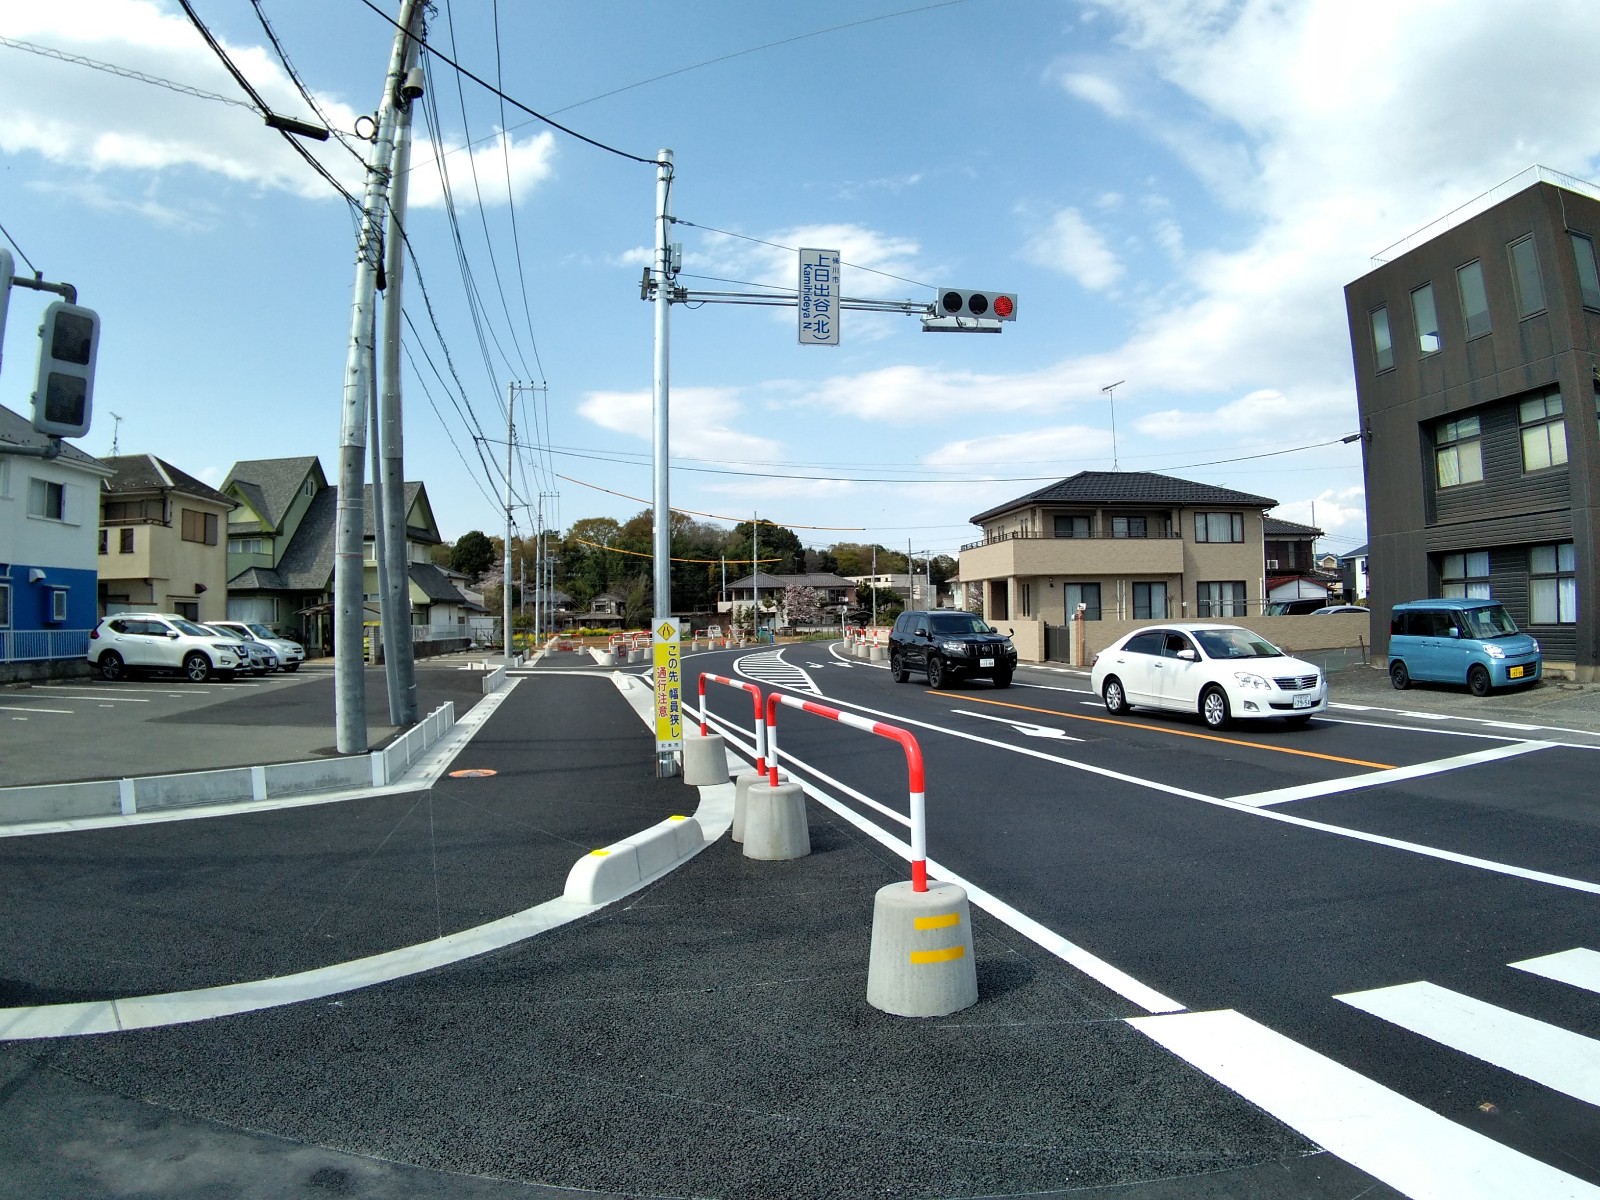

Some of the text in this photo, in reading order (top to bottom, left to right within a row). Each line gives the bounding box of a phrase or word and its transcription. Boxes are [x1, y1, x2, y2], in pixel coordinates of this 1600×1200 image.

[801, 263, 812, 332] Kamihideya N.
[813, 254, 830, 340] 上日出谷(北)
[656, 667, 668, 718] 通行注意
[668, 645, 680, 738] この先 幅員狭し
